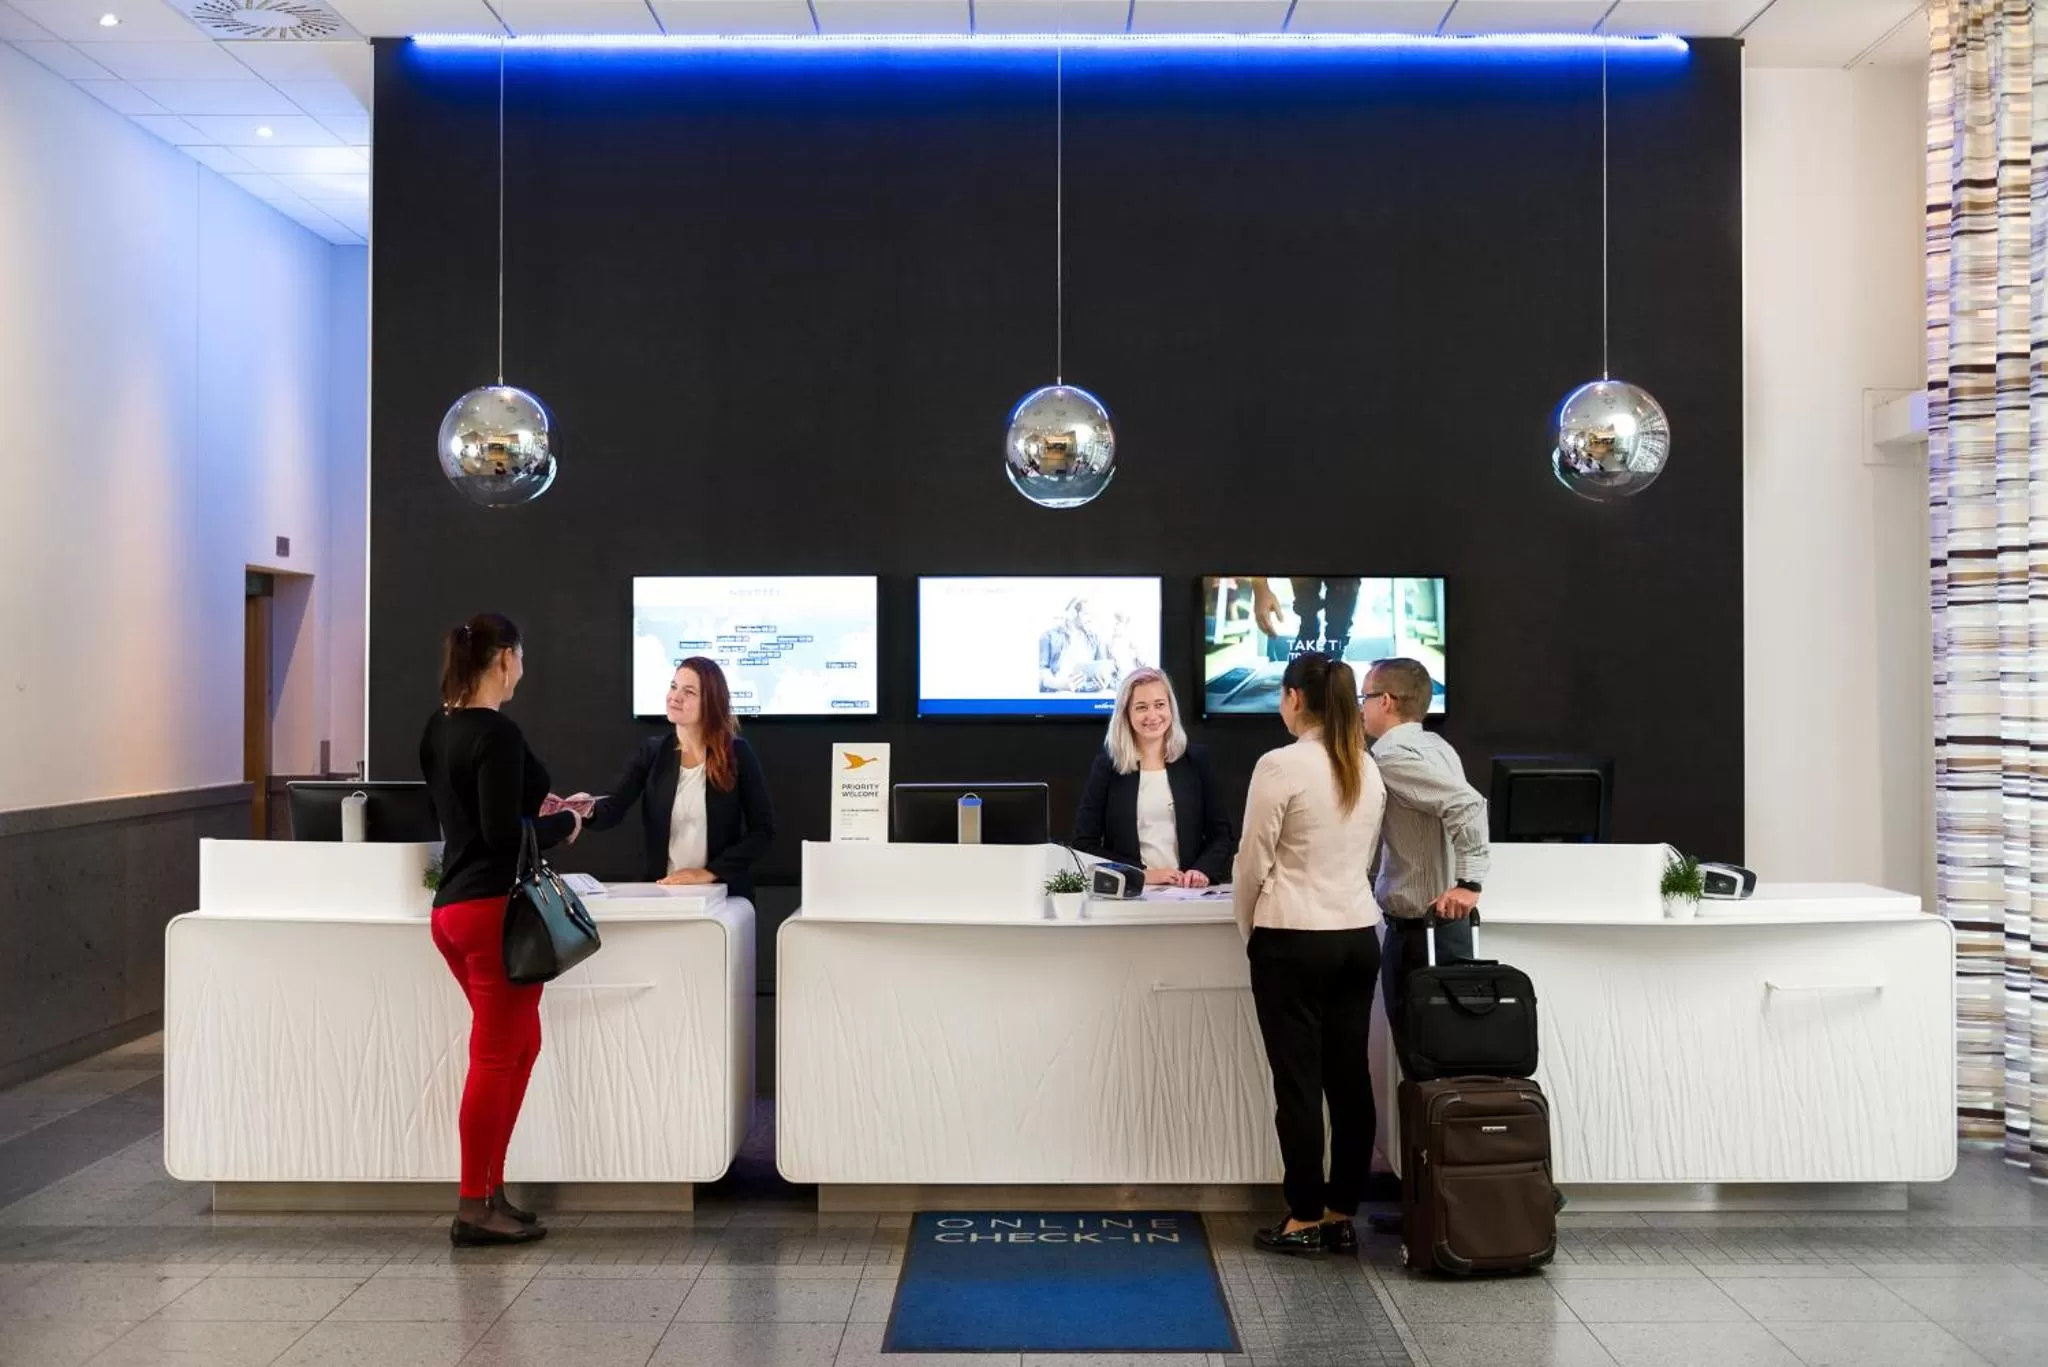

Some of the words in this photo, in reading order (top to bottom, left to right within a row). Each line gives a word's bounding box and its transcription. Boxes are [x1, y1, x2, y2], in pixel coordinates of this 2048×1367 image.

[1286, 639, 1325, 652] TAKE
[936, 1218, 1178, 1229] ONLINE
[934, 1232, 1180, 1243] CHECK-IN
